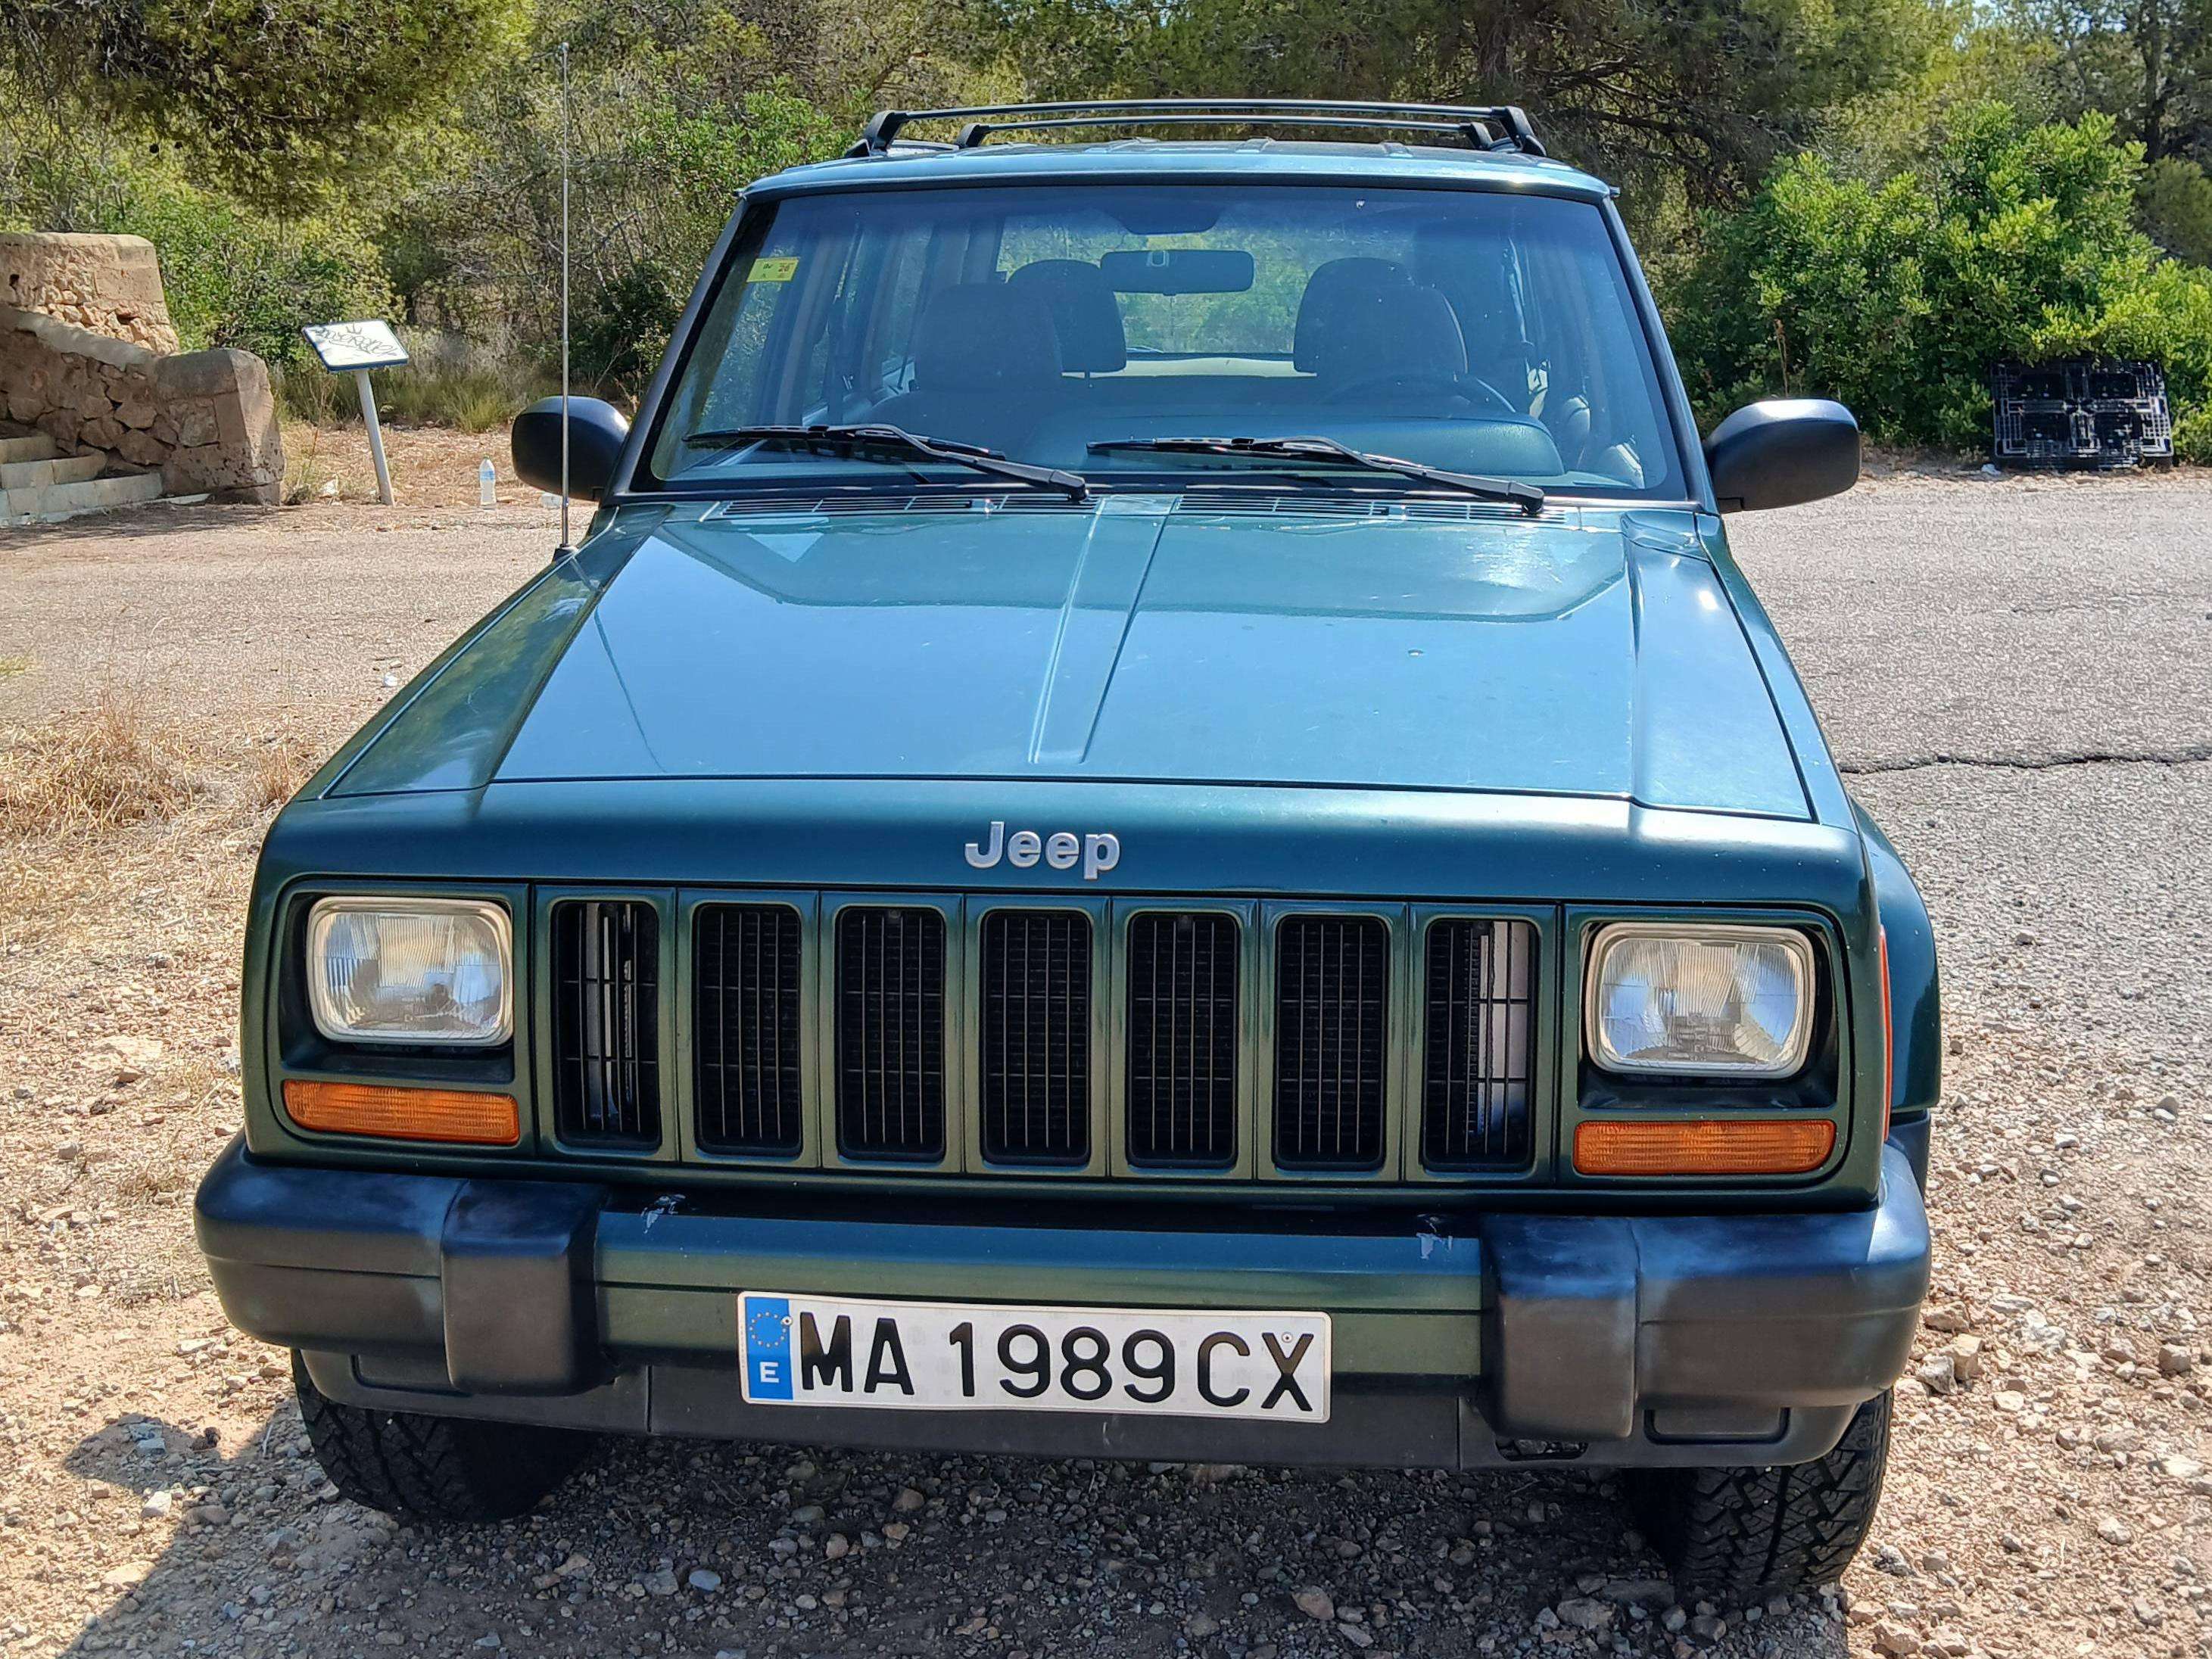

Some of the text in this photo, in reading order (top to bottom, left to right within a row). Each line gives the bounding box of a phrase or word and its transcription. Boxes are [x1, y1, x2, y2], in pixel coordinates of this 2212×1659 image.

[964, 821, 1120, 880] Jeep
[759, 1361, 780, 1384] E
[799, 1312, 914, 1395] MA
[949, 1321, 1176, 1403] 1989
[1197, 1331, 1315, 1412] CX
